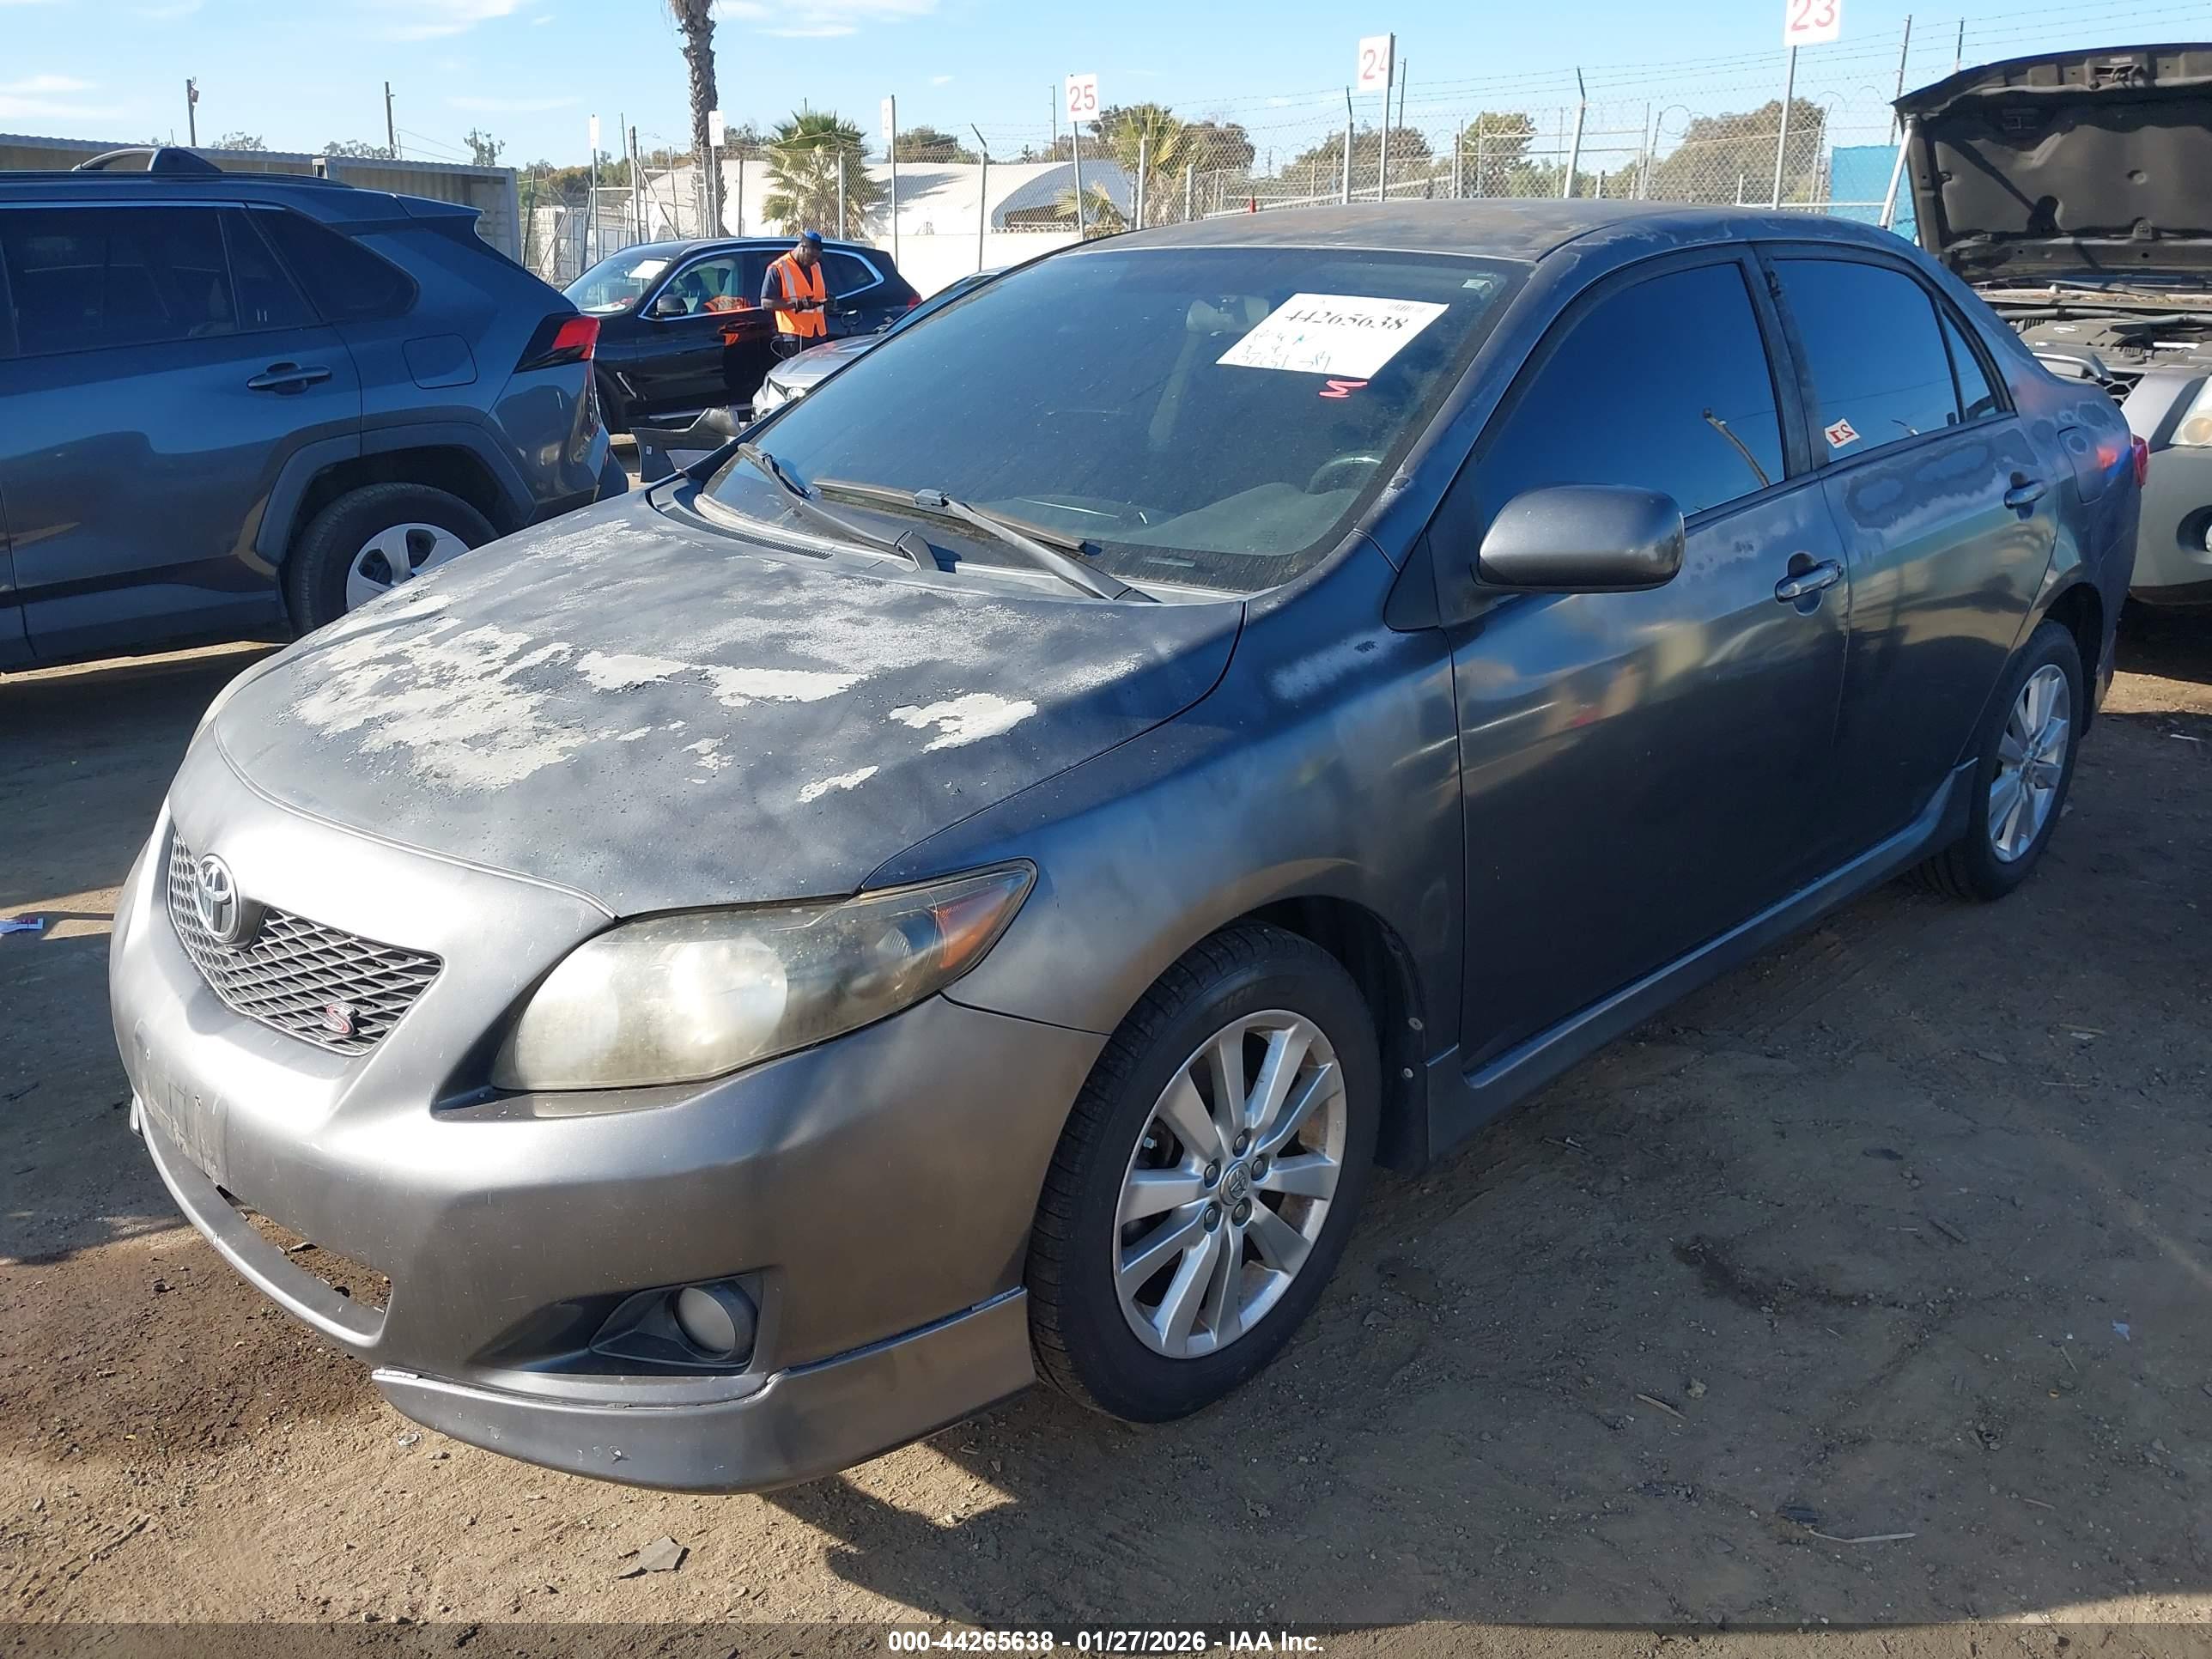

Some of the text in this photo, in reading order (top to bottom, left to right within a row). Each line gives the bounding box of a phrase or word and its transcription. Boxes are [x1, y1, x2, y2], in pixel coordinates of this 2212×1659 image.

[1791, 0, 1835, 31] 23
[1070, 84, 1095, 112] 25
[1285, 308, 1409, 331] 44265638
